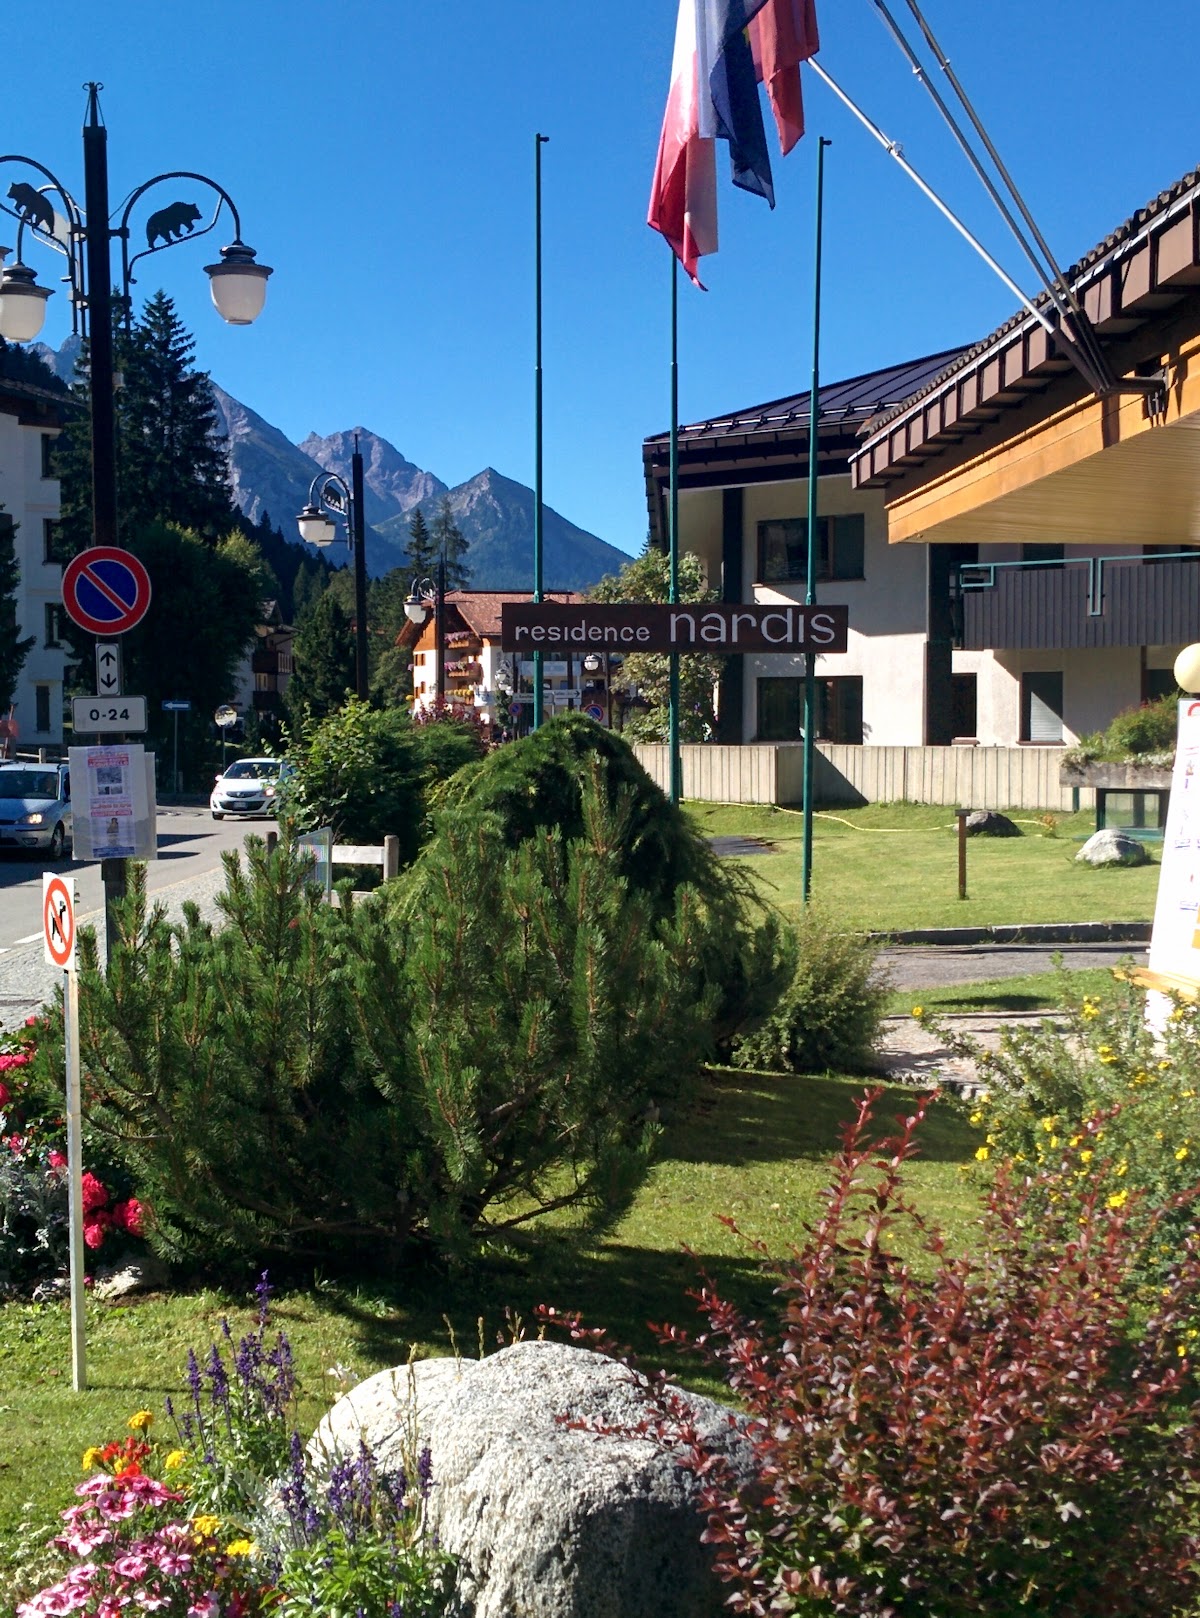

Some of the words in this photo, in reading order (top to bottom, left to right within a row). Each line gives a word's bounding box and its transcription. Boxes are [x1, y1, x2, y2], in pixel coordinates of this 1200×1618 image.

[514, 619, 651, 642] residence
[669, 607, 836, 644] nardis
[89, 708, 130, 721] 0-24
